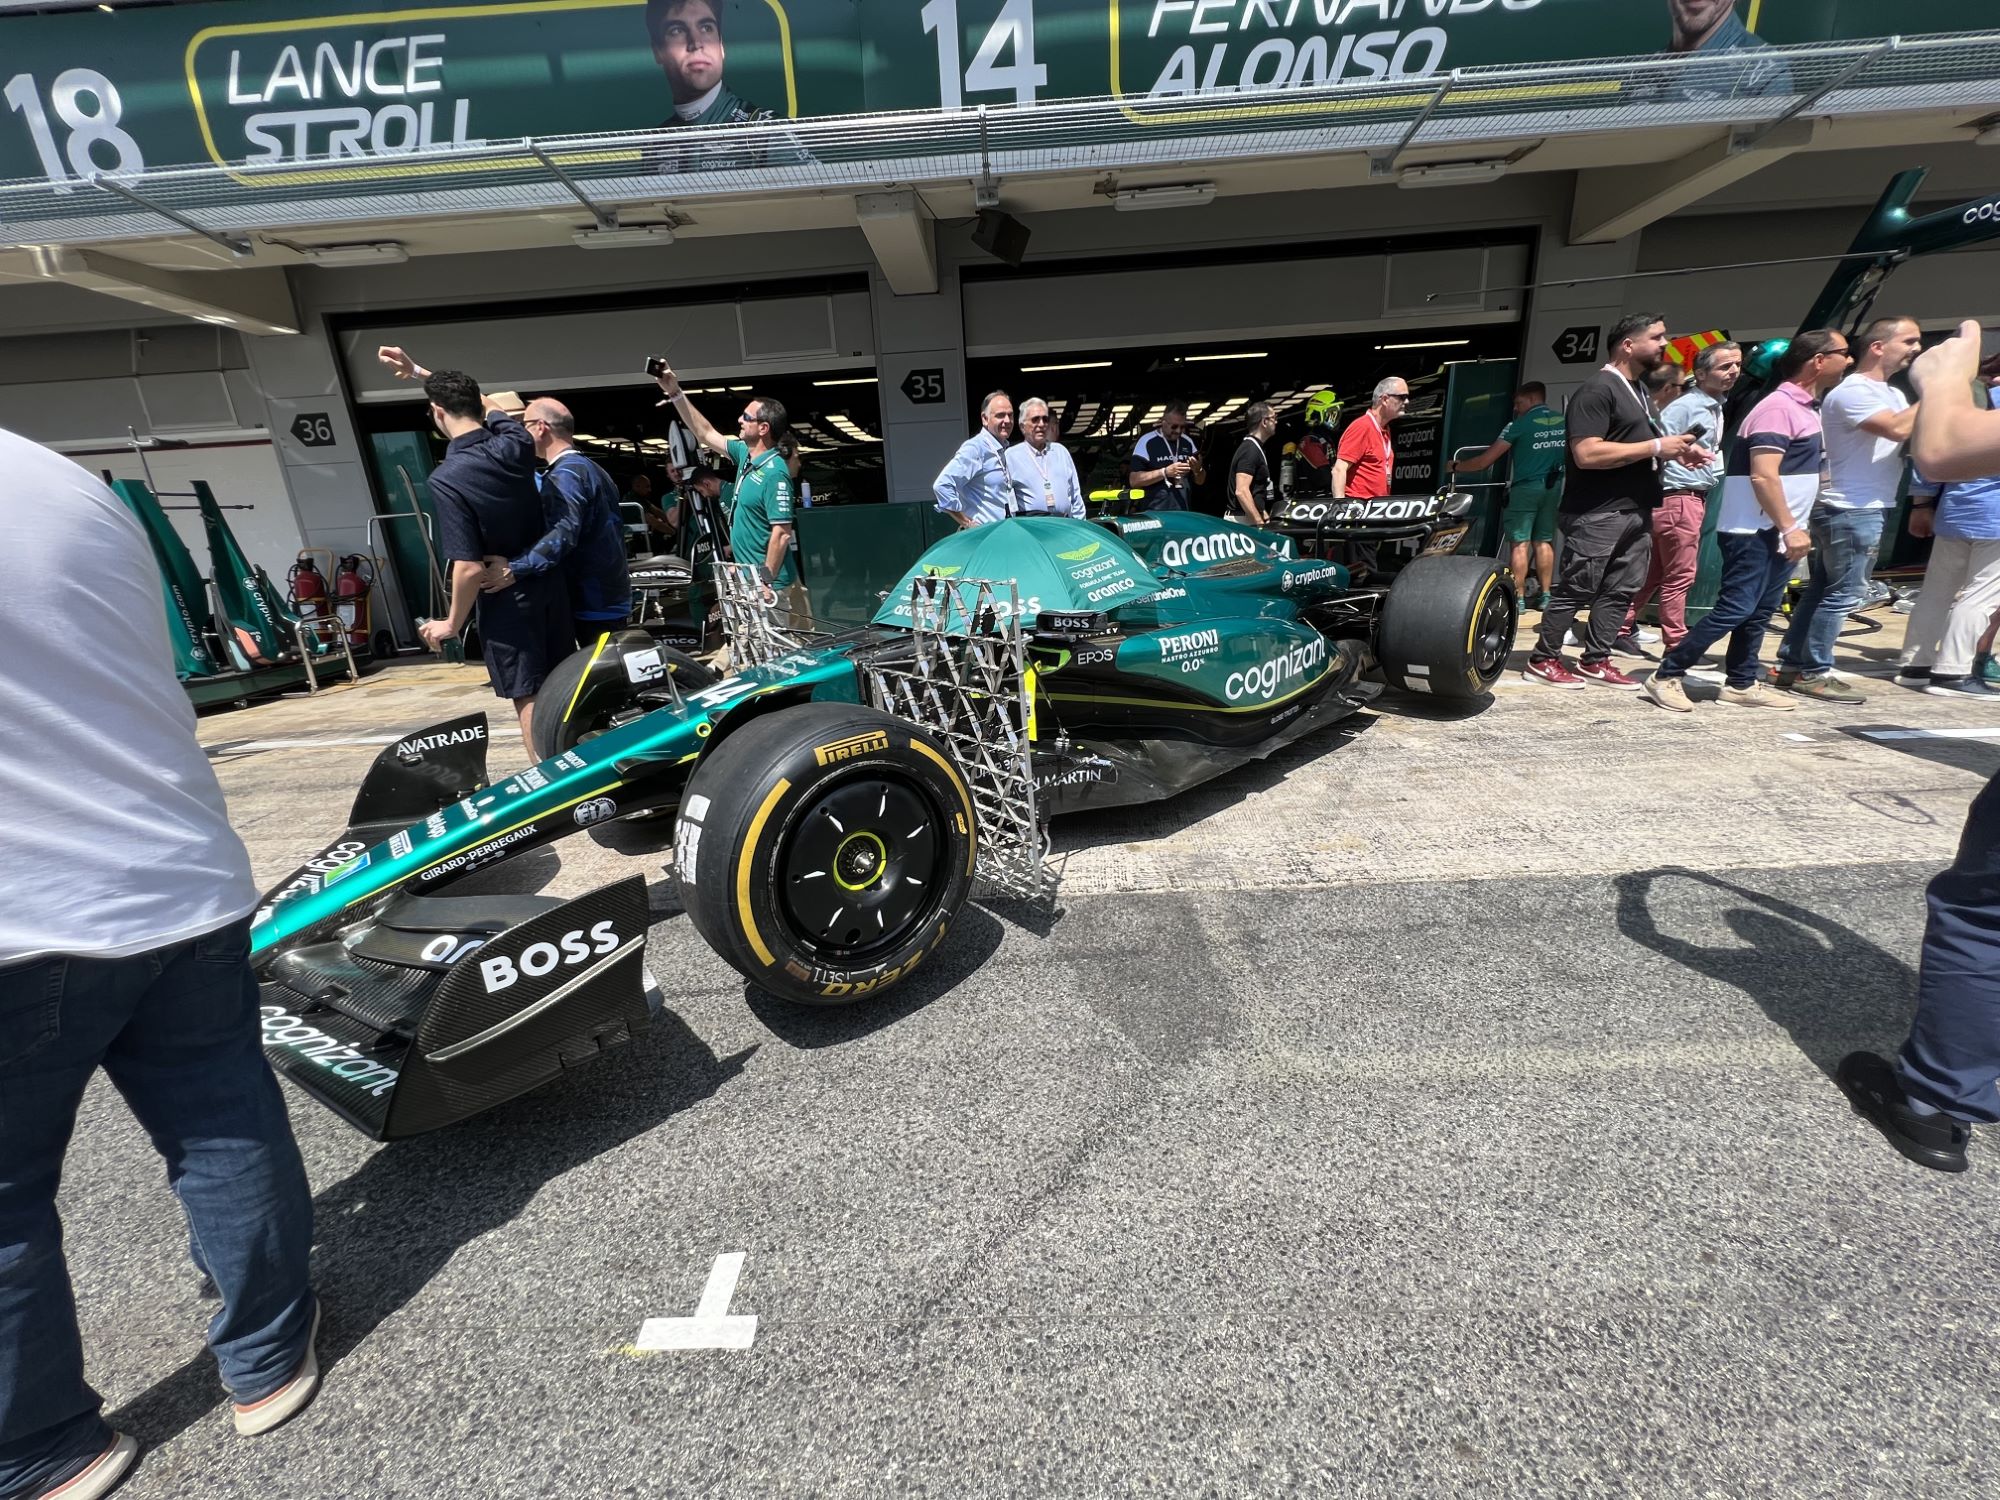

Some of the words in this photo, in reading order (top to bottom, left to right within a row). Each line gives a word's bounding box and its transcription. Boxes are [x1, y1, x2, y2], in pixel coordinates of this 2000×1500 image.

[1148, 0, 1543, 37] FERNA
[228, 34, 446, 104] LANCE
[922, 0, 1047, 114] 14
[1147, 27, 1447, 100] ALONSO
[4, 68, 144, 194] 18
[245, 99, 487, 166] STROLL
[1562, 332, 1596, 358] 34
[911, 374, 942, 399] 35
[298, 418, 331, 441] 36
[1156, 454, 1188, 463] HACET
[1395, 464, 1431, 480] aramco
[1291, 496, 1439, 521] conizant
[1122, 519, 1163, 534] BOMBARDIER
[697, 542, 711, 553] BOSS
[1162, 532, 1257, 567] aramco
[1430, 532, 1463, 551] JCB
[1071, 556, 1120, 579] cognizant
[1294, 566, 1337, 586] crypto.com
[1087, 577, 1135, 602] aramco
[1053, 617, 1090, 629] BOSS
[1158, 628, 1219, 656] PERONI
[1161, 653, 1188, 664] NASTRO
[1188, 646, 1219, 657] AZZURRO
[1225, 632, 1326, 700] cognizant
[396, 725, 487, 757] AVATRADE
[813, 730, 890, 767] PIRELLI
[1044, 768, 1102, 788] MARTIN
[420, 824, 538, 881] GIRARD-PERREGAUX
[479, 920, 620, 994] BOSS
[820, 950, 924, 997] ZERO
